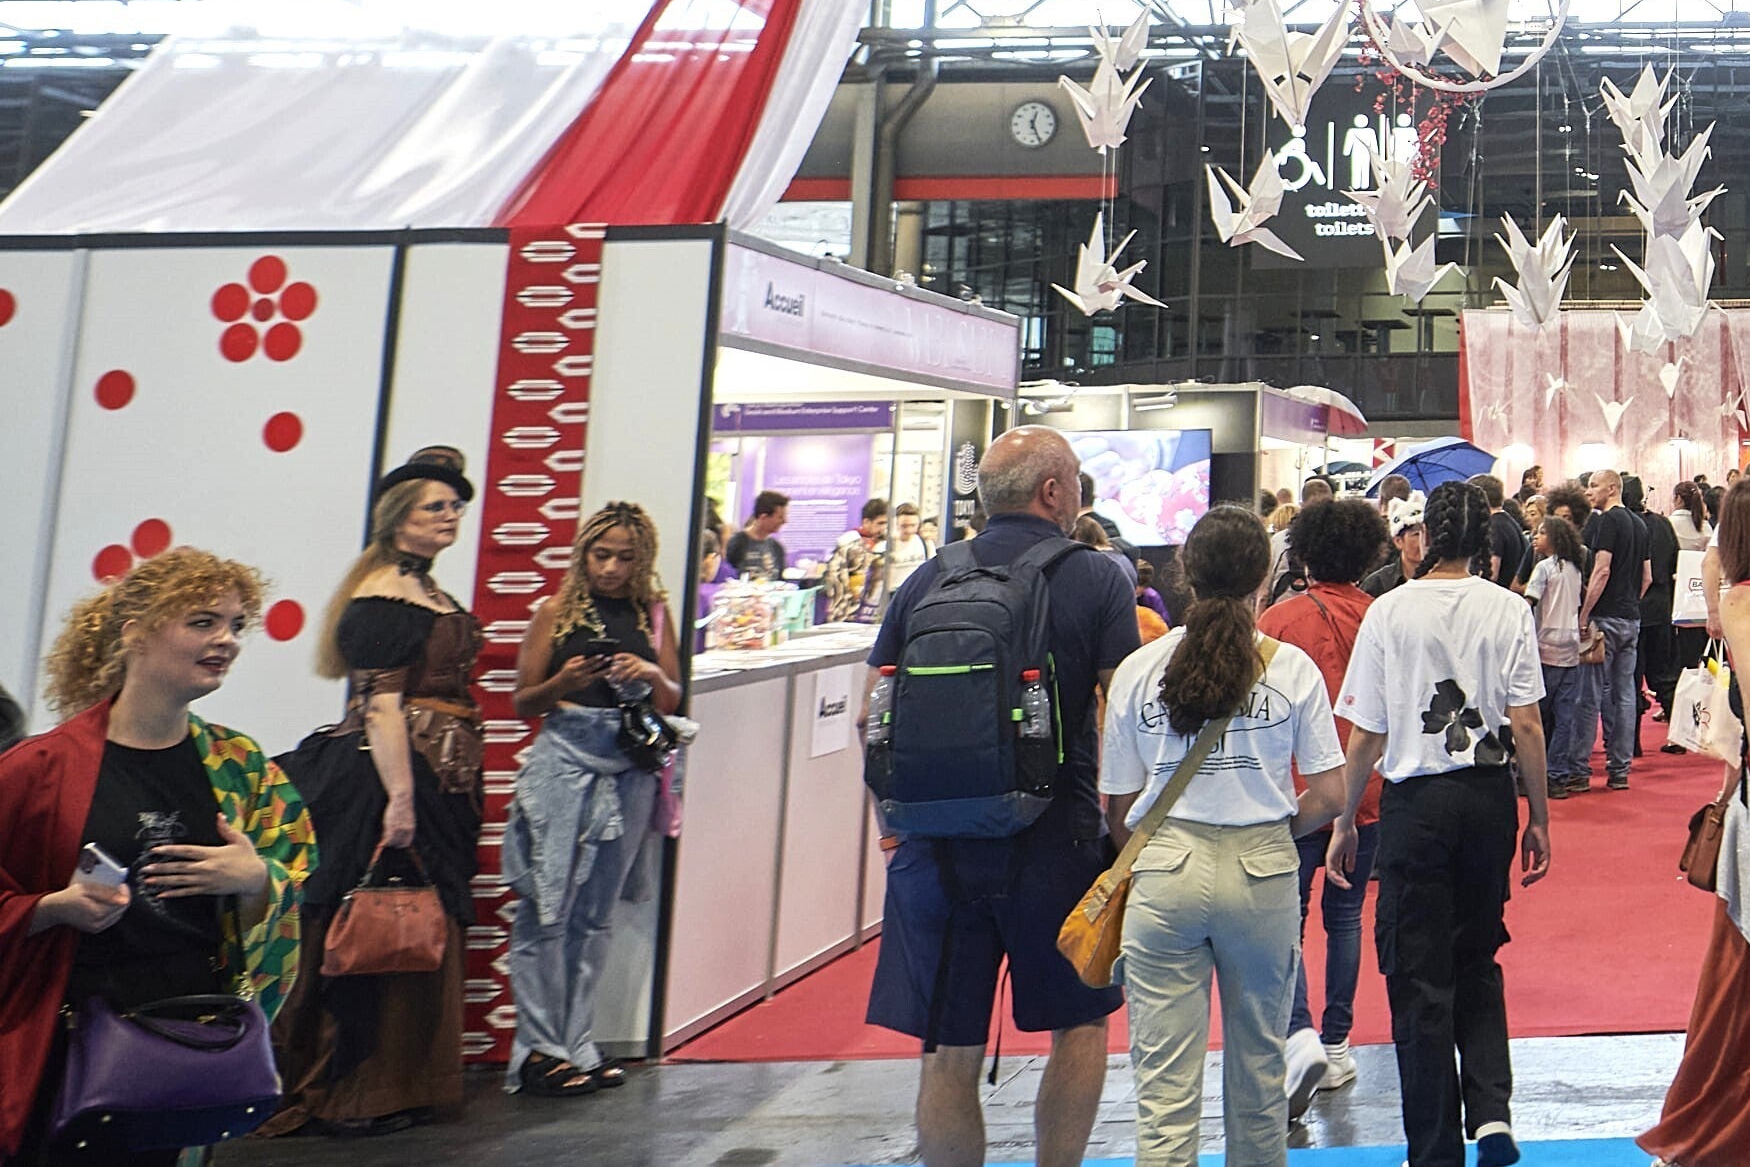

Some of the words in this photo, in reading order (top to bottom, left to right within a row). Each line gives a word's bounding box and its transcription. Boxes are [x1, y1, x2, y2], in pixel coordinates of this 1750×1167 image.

[1305, 202, 1376, 218] toilett
[1314, 221, 1375, 236] toilets
[764, 281, 805, 318] Accueil
[819, 695, 848, 719] Accueil
